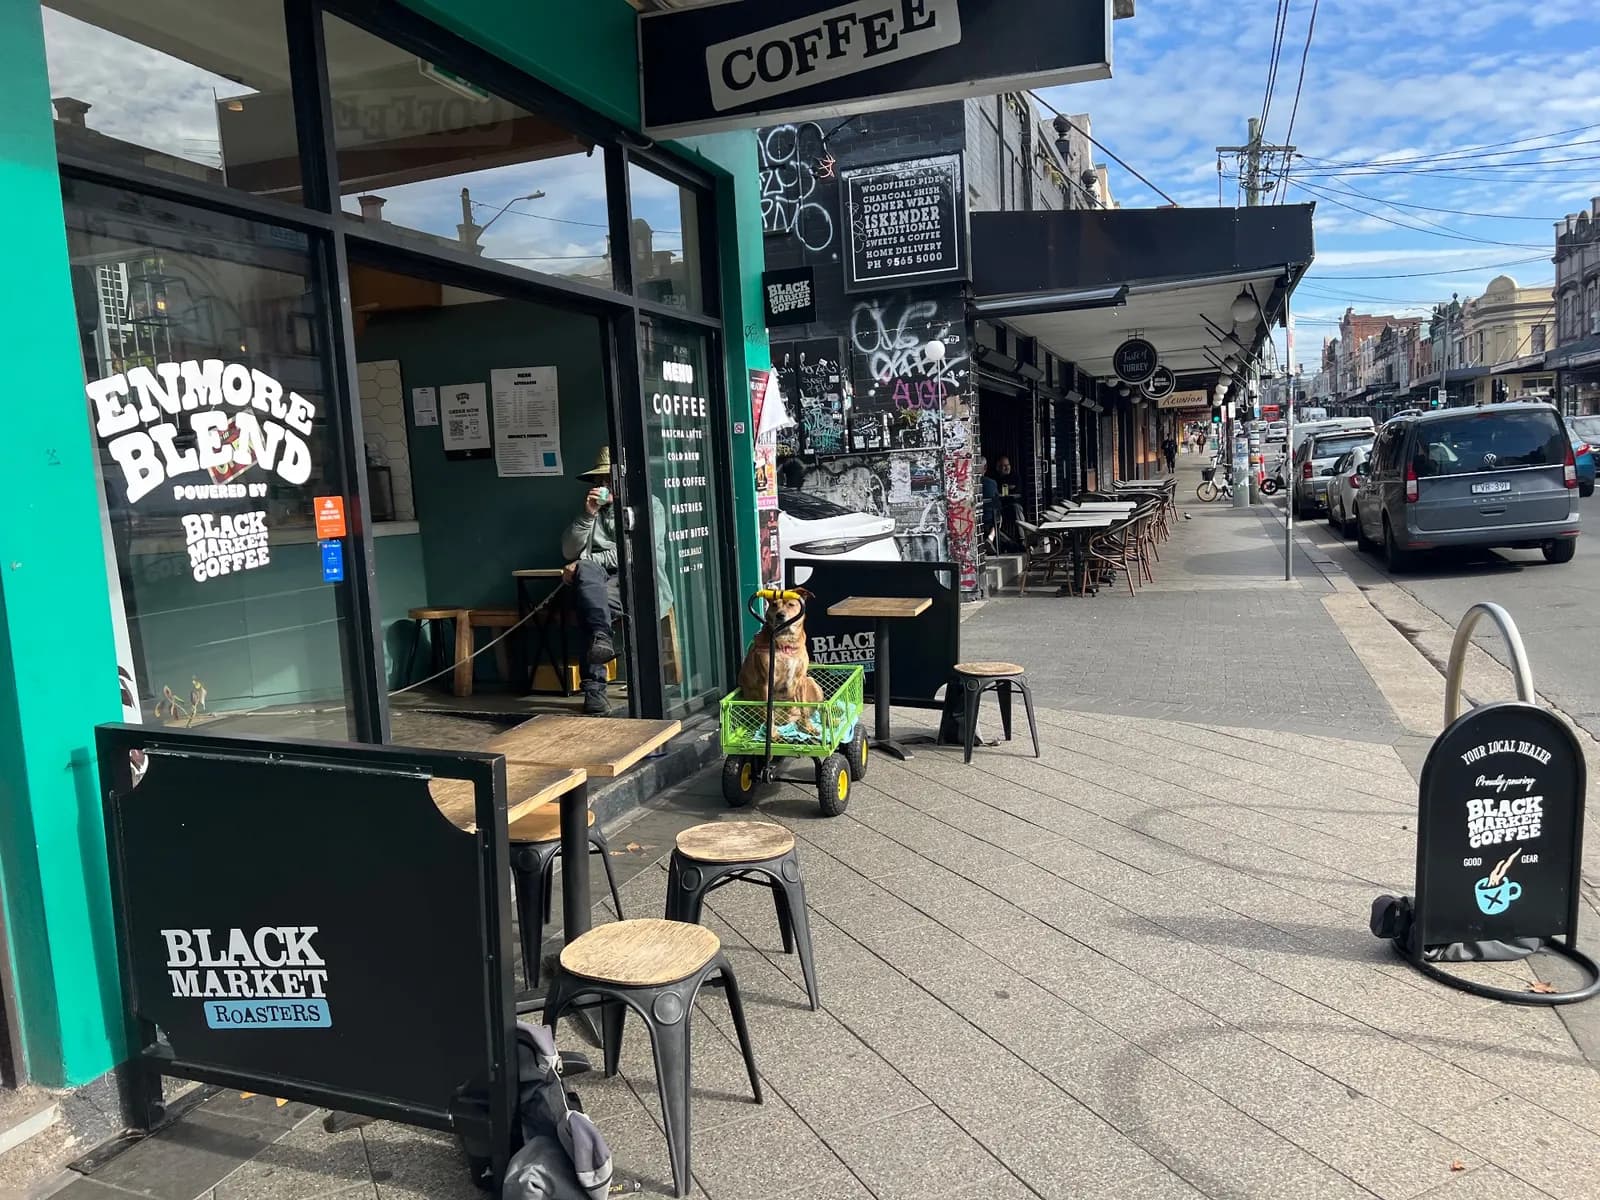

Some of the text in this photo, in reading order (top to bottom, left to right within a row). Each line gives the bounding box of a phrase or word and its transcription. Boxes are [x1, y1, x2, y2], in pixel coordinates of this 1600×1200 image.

[721, 0, 936, 91] COFFEE
[861, 179, 916, 193] WOODFIRED
[863, 186, 940, 203] CHARCOAL SHISH
[864, 195, 940, 214] DONER WRAP
[864, 205, 940, 229] ISKENDER
[866, 220, 940, 238] TRADITIONAL
[866, 231, 941, 248] SWEETS & COFFEE
[866, 241, 942, 259] HOME DELIVERY
[867, 252, 943, 270] PH 9565 5000
[767, 280, 810, 298] BLACK
[770, 290, 811, 308] MARKET
[772, 298, 811, 314] COFFEE
[663, 361, 693, 384] MENU
[1122, 362, 1149, 373] TURKEY
[85, 359, 316, 438] ENMORE
[653, 393, 706, 417] COFFEE
[662, 429, 702, 439] MATCHA LATTE
[108, 410, 312, 504] BLEND
[668, 452, 700, 461] COLD BREW
[664, 476, 706, 488] ICED COFFEE
[173, 483, 267, 500] POWERED BY
[672, 502, 703, 514] PASTRIES
[181, 511, 268, 545] BLACK
[668, 526, 709, 541] LIGHT BITES
[187, 532, 269, 568] MARKET
[193, 546, 270, 583] COFFEE
[813, 649, 875, 664] MARKE
[1460, 740, 1552, 765] YOUR LOCAL DEALER
[1466, 796, 1544, 821] BLACK
[1468, 811, 1543, 837] MARKET
[1470, 823, 1541, 848] COFFEE
[1463, 854, 1539, 867] GOOD GEAR
[160, 926, 325, 968] BLACK
[167, 969, 328, 998] MARKET
[213, 1004, 321, 1024] ROASTERS
